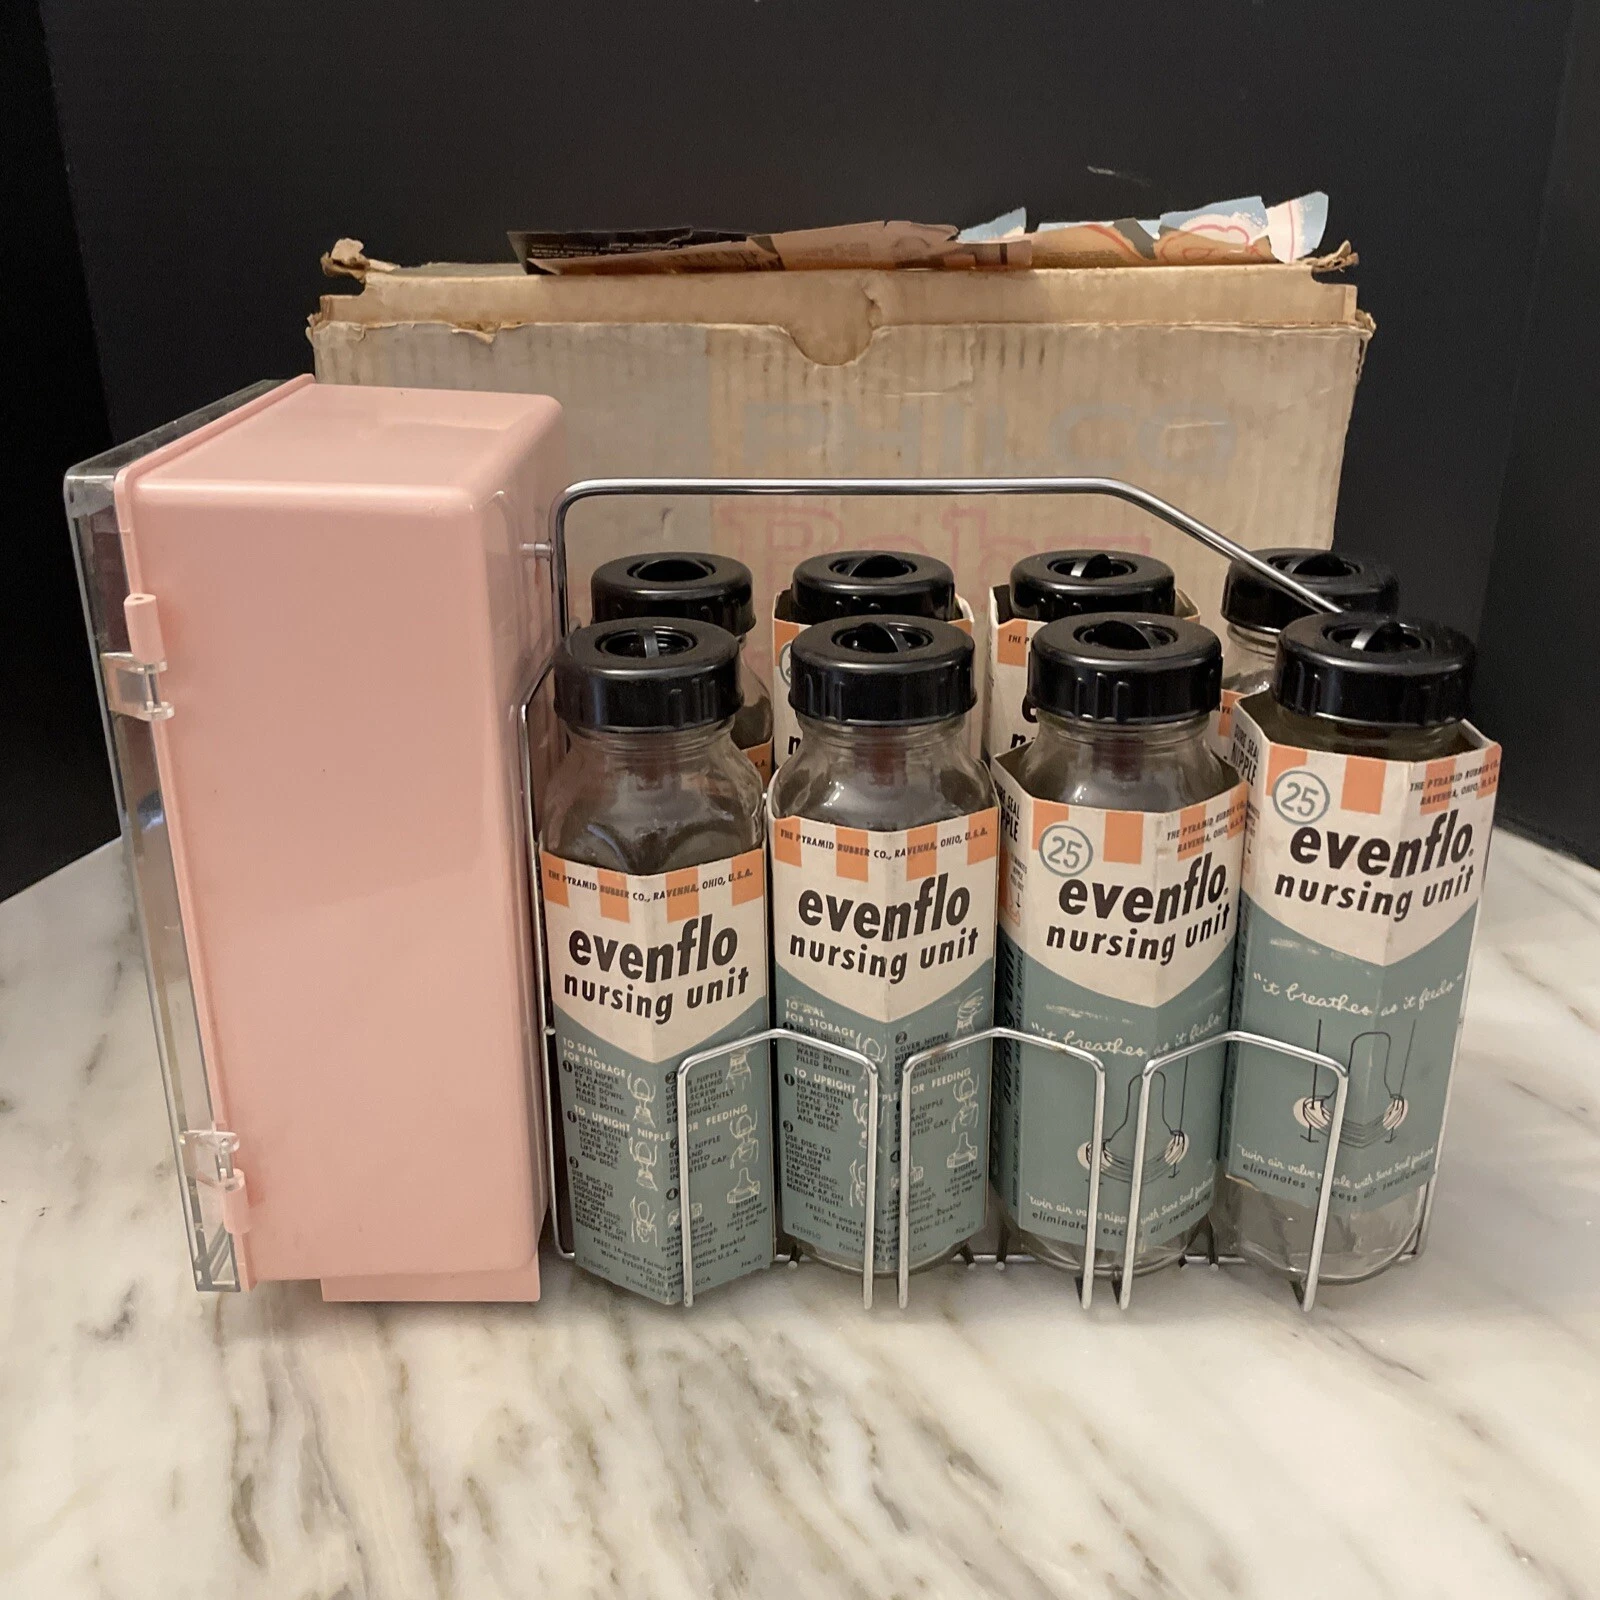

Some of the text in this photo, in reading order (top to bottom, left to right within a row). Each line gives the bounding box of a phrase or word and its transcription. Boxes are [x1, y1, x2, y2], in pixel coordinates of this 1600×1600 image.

[742, 401, 1238, 476] PHILCO
[1281, 782, 1319, 816] 25
[780, 829, 793, 841] THE
[796, 833, 834, 850] PYRAMID
[837, 843, 870, 857] RUBBER
[895, 840, 937, 858] RAVENNA,
[1047, 836, 1083, 869] 25
[548, 869, 560, 880] THE
[562, 875, 598, 891] PYRAMID
[600, 885, 630, 899] RUBBER
[653, 883, 699, 901] RAVENNA,
[702, 876, 726, 889] OHIO,
[1274, 864, 1474, 923] nursing unit
[798, 872, 970, 942] evenflo
[568, 913, 738, 983] evenflo
[1046, 902, 1230, 966] nursing unit
[790, 927, 978, 985] nursing unit
[564, 966, 749, 1025] nursing unit
[785, 998, 798, 1011] TO
[1285, 982, 1372, 1016] breathes
[785, 1011, 855, 1038] FOR STORAGE
[563, 1037, 598, 1057] TO SEAL
[1063, 1031, 1146, 1057] breathes
[563, 1049, 626, 1078] FOR STORAGE
[794, 1067, 807, 1078] TO
[813, 1073, 856, 1094] UPRIGHT
[931, 1067, 971, 1088] FEEDING
[574, 1104, 586, 1116] TO
[592, 1111, 630, 1132] UPRIGHT
[637, 1127, 671, 1142] NIPPLE
[706, 1104, 748, 1126] FEEDING
[1242, 1163, 1306, 1189] eliminates
[1032, 1210, 1088, 1231] eliminate
